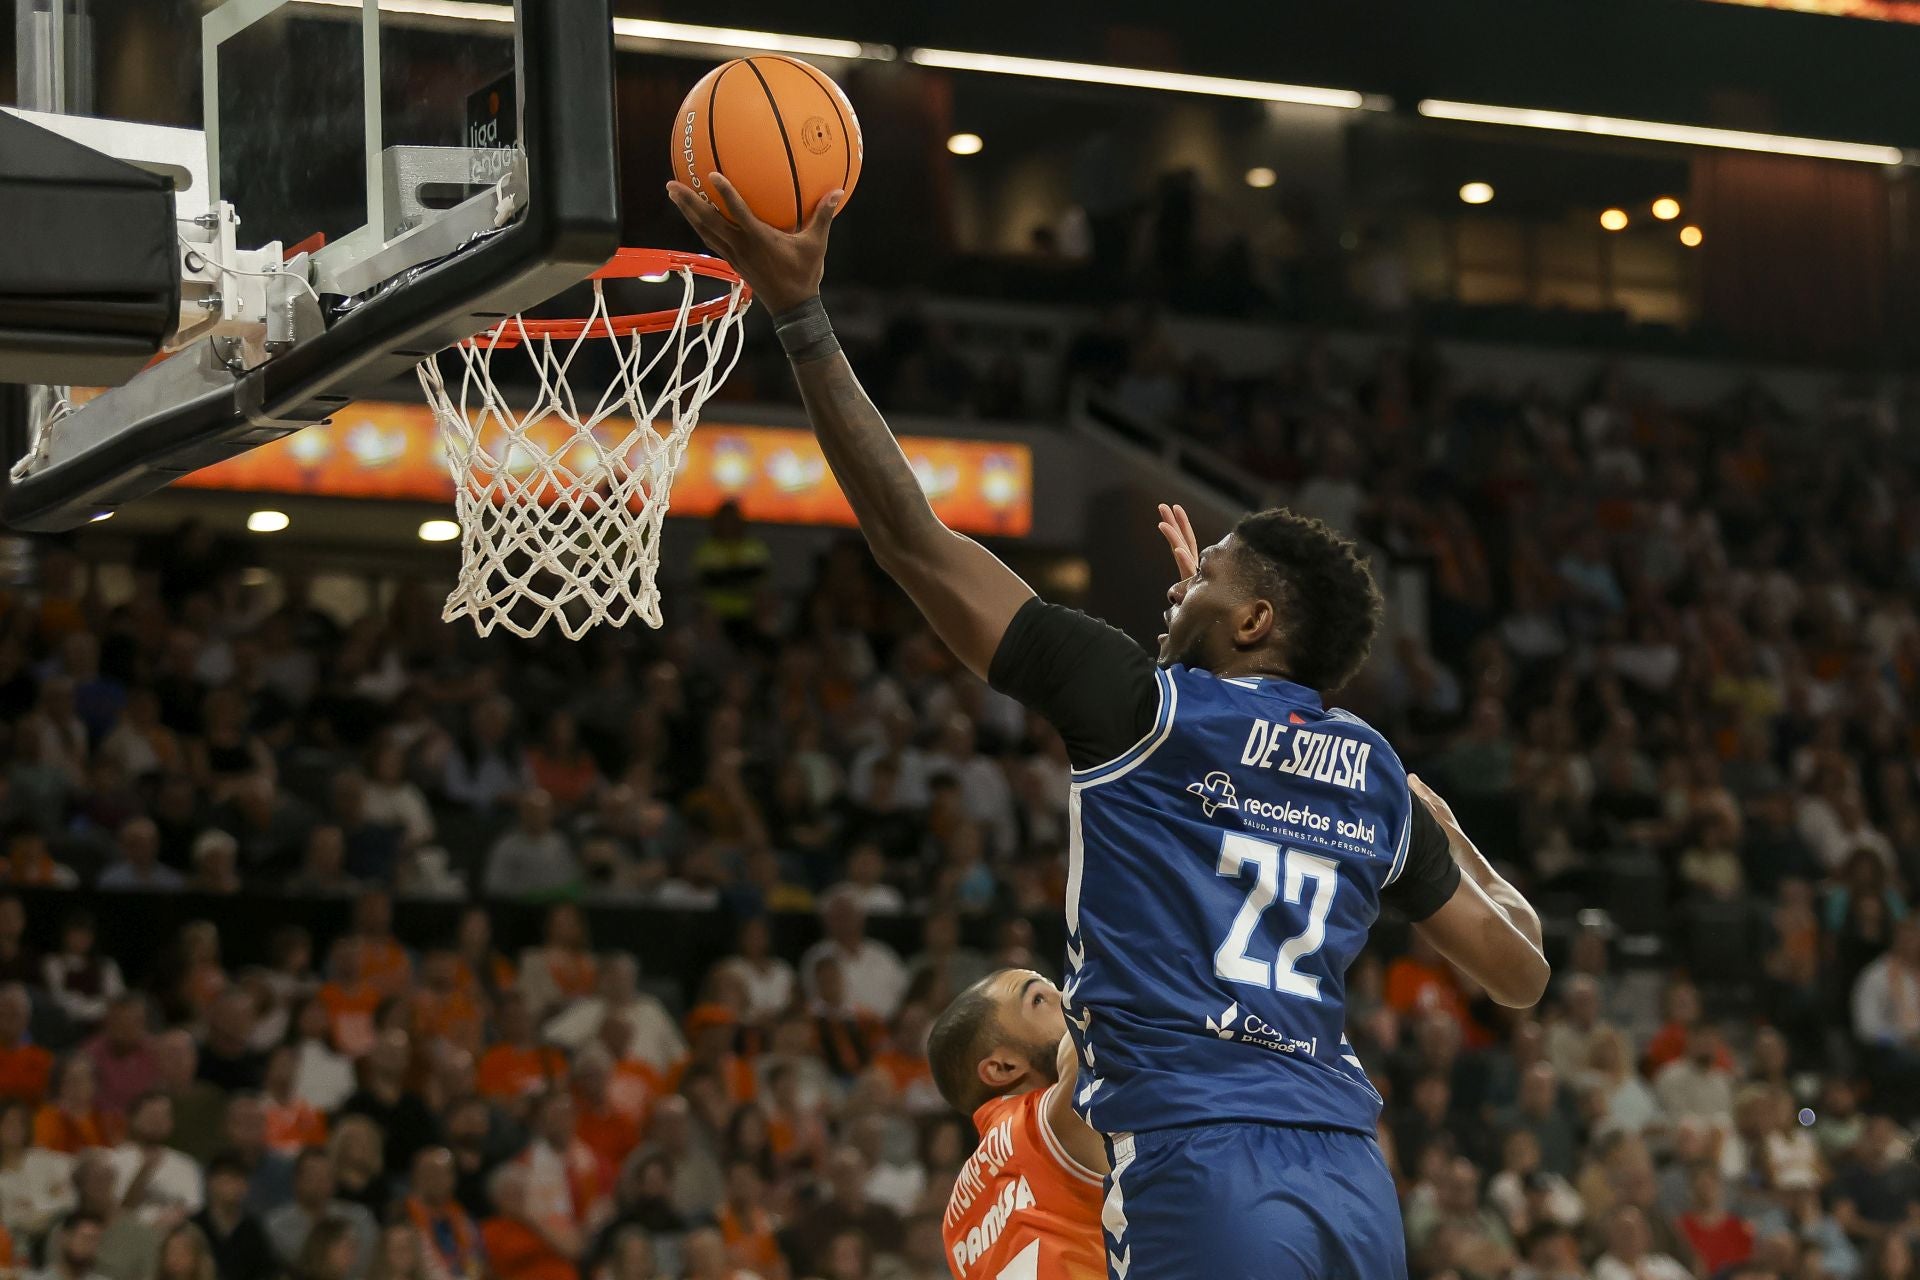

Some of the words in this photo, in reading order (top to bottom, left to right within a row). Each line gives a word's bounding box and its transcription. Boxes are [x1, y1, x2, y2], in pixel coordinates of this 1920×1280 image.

[470, 118, 497, 150] liga
[683, 111, 701, 188] endesa
[1240, 718, 1289, 769] DE
[1278, 729, 1372, 792] SOUSA
[1244, 798, 1331, 832] recoletas
[1336, 818, 1375, 844] salud
[1213, 830, 1341, 1002] 22
